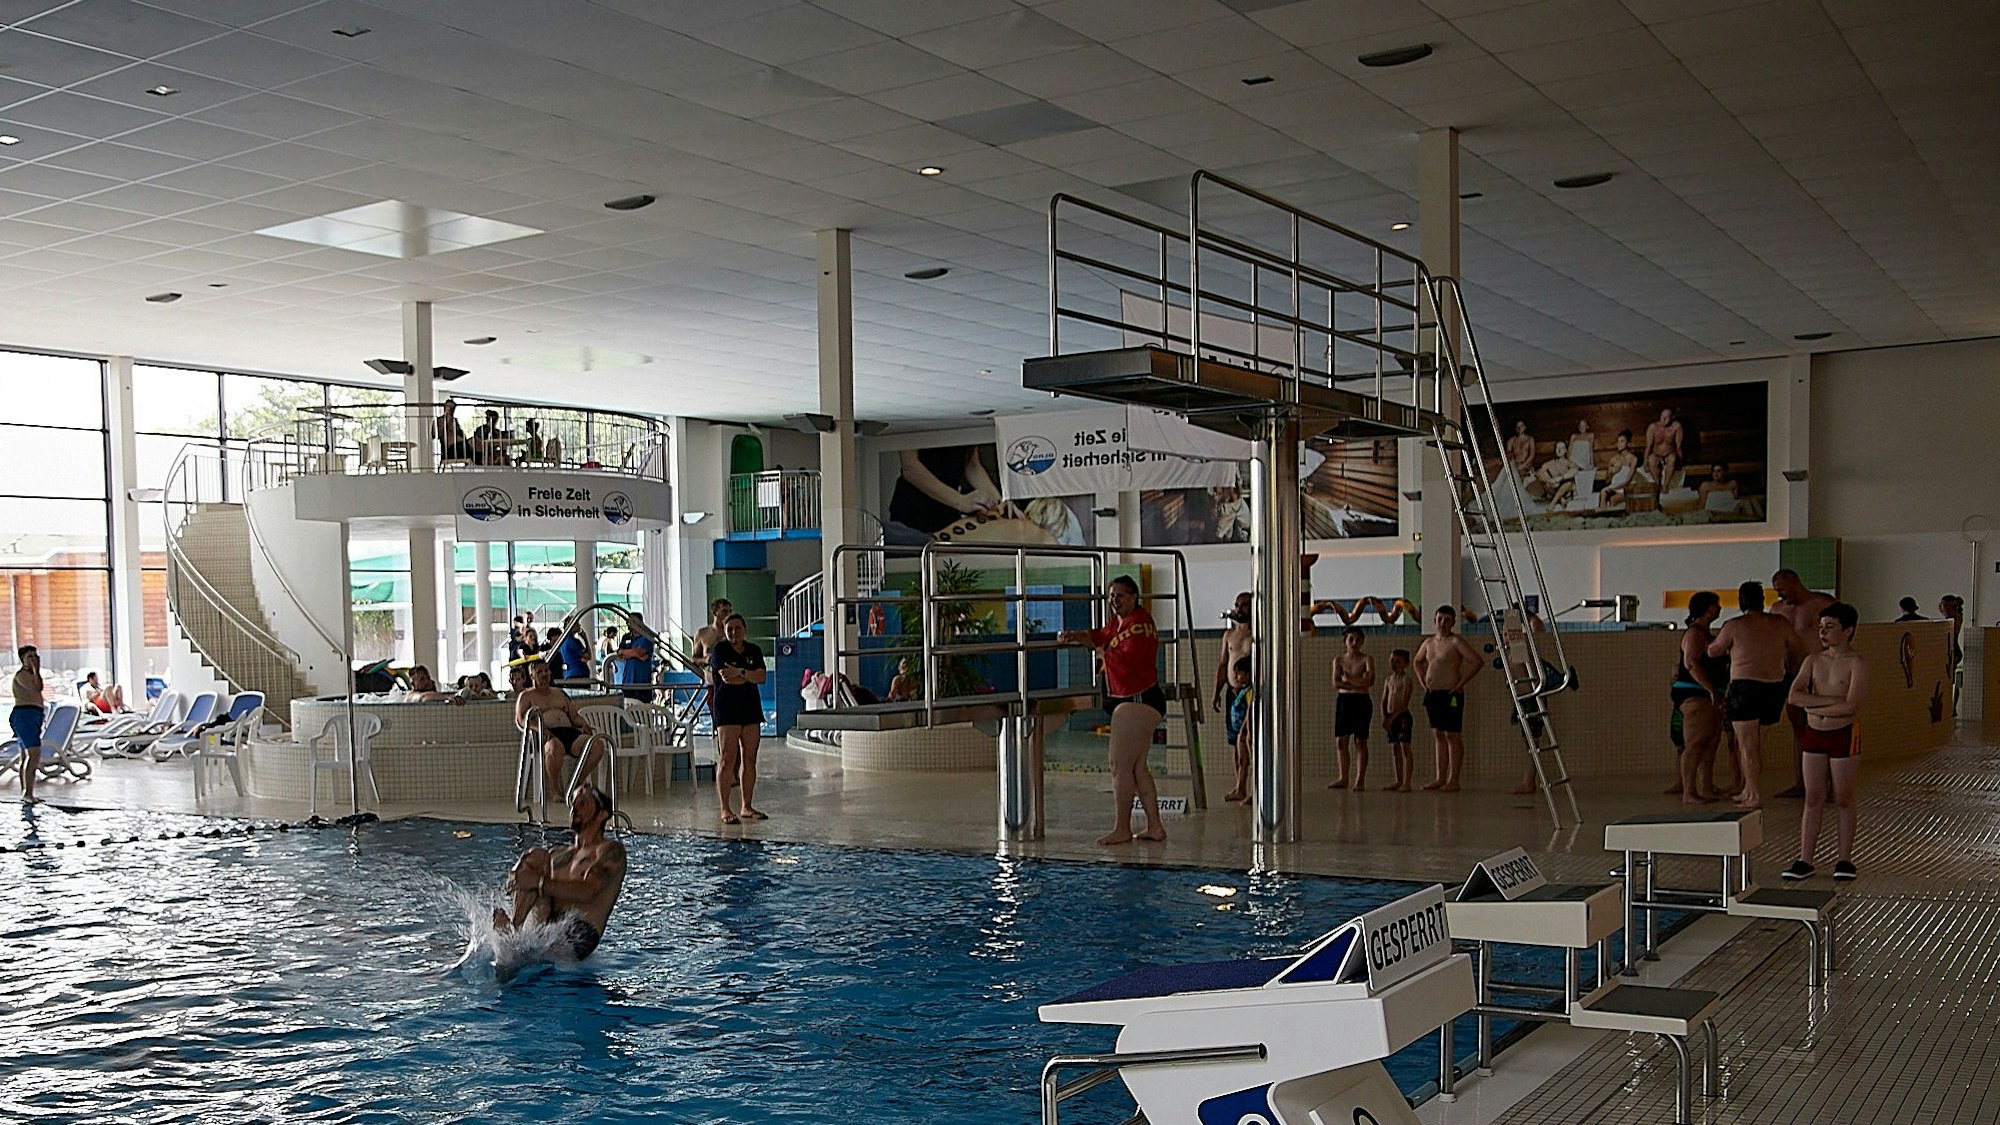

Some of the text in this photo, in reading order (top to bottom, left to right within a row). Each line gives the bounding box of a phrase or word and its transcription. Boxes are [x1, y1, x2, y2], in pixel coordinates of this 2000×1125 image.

[528, 486, 591, 501] Freie Zeit
[517, 504, 531, 517] in
[535, 504, 600, 519] Sicherheit
[1490, 855, 1540, 891] GESPERRT
[1370, 901, 1446, 972] GESPERRT
